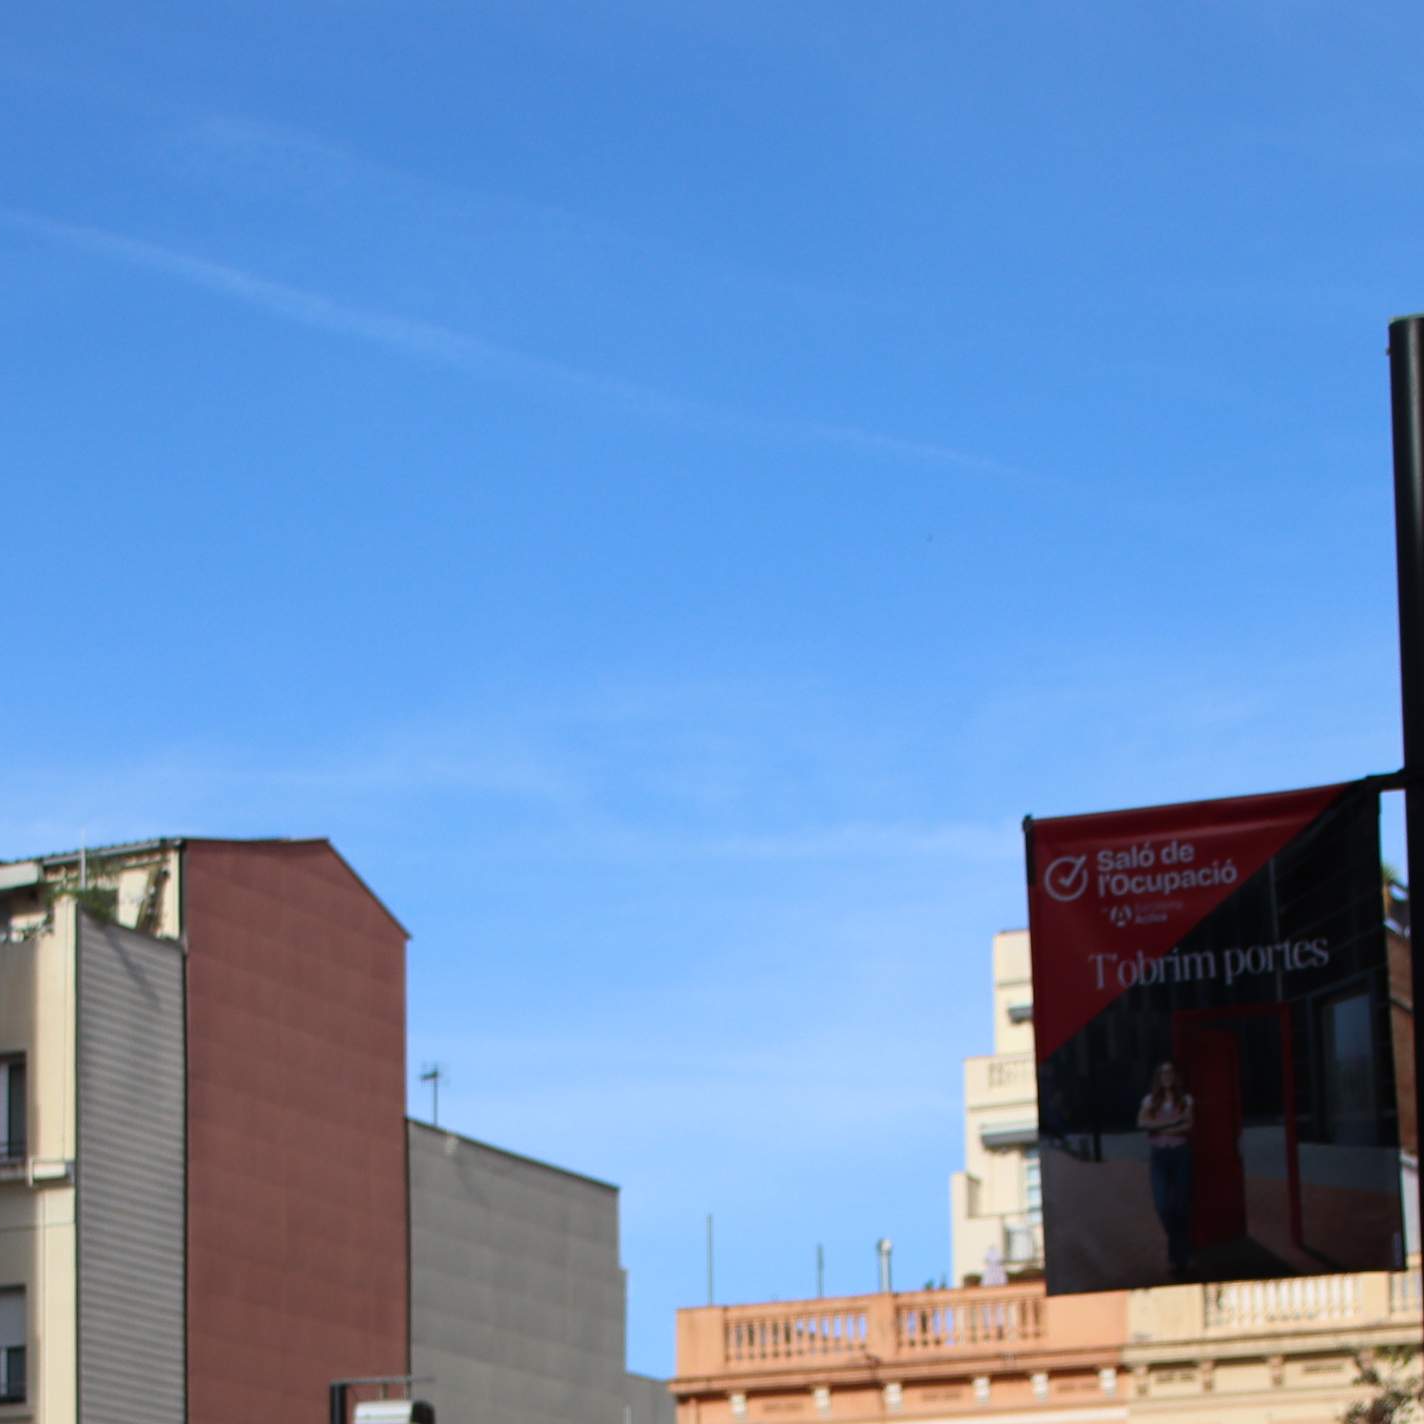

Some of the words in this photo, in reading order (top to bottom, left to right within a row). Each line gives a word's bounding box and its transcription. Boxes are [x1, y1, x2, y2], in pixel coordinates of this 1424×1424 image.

[1095, 841, 1155, 872] Saló
[1160, 838, 1196, 865] de
[1096, 858, 1239, 898] l'Ocupació
[1087, 946, 1218, 991] T'obrim
[1222, 935, 1330, 987] portes
